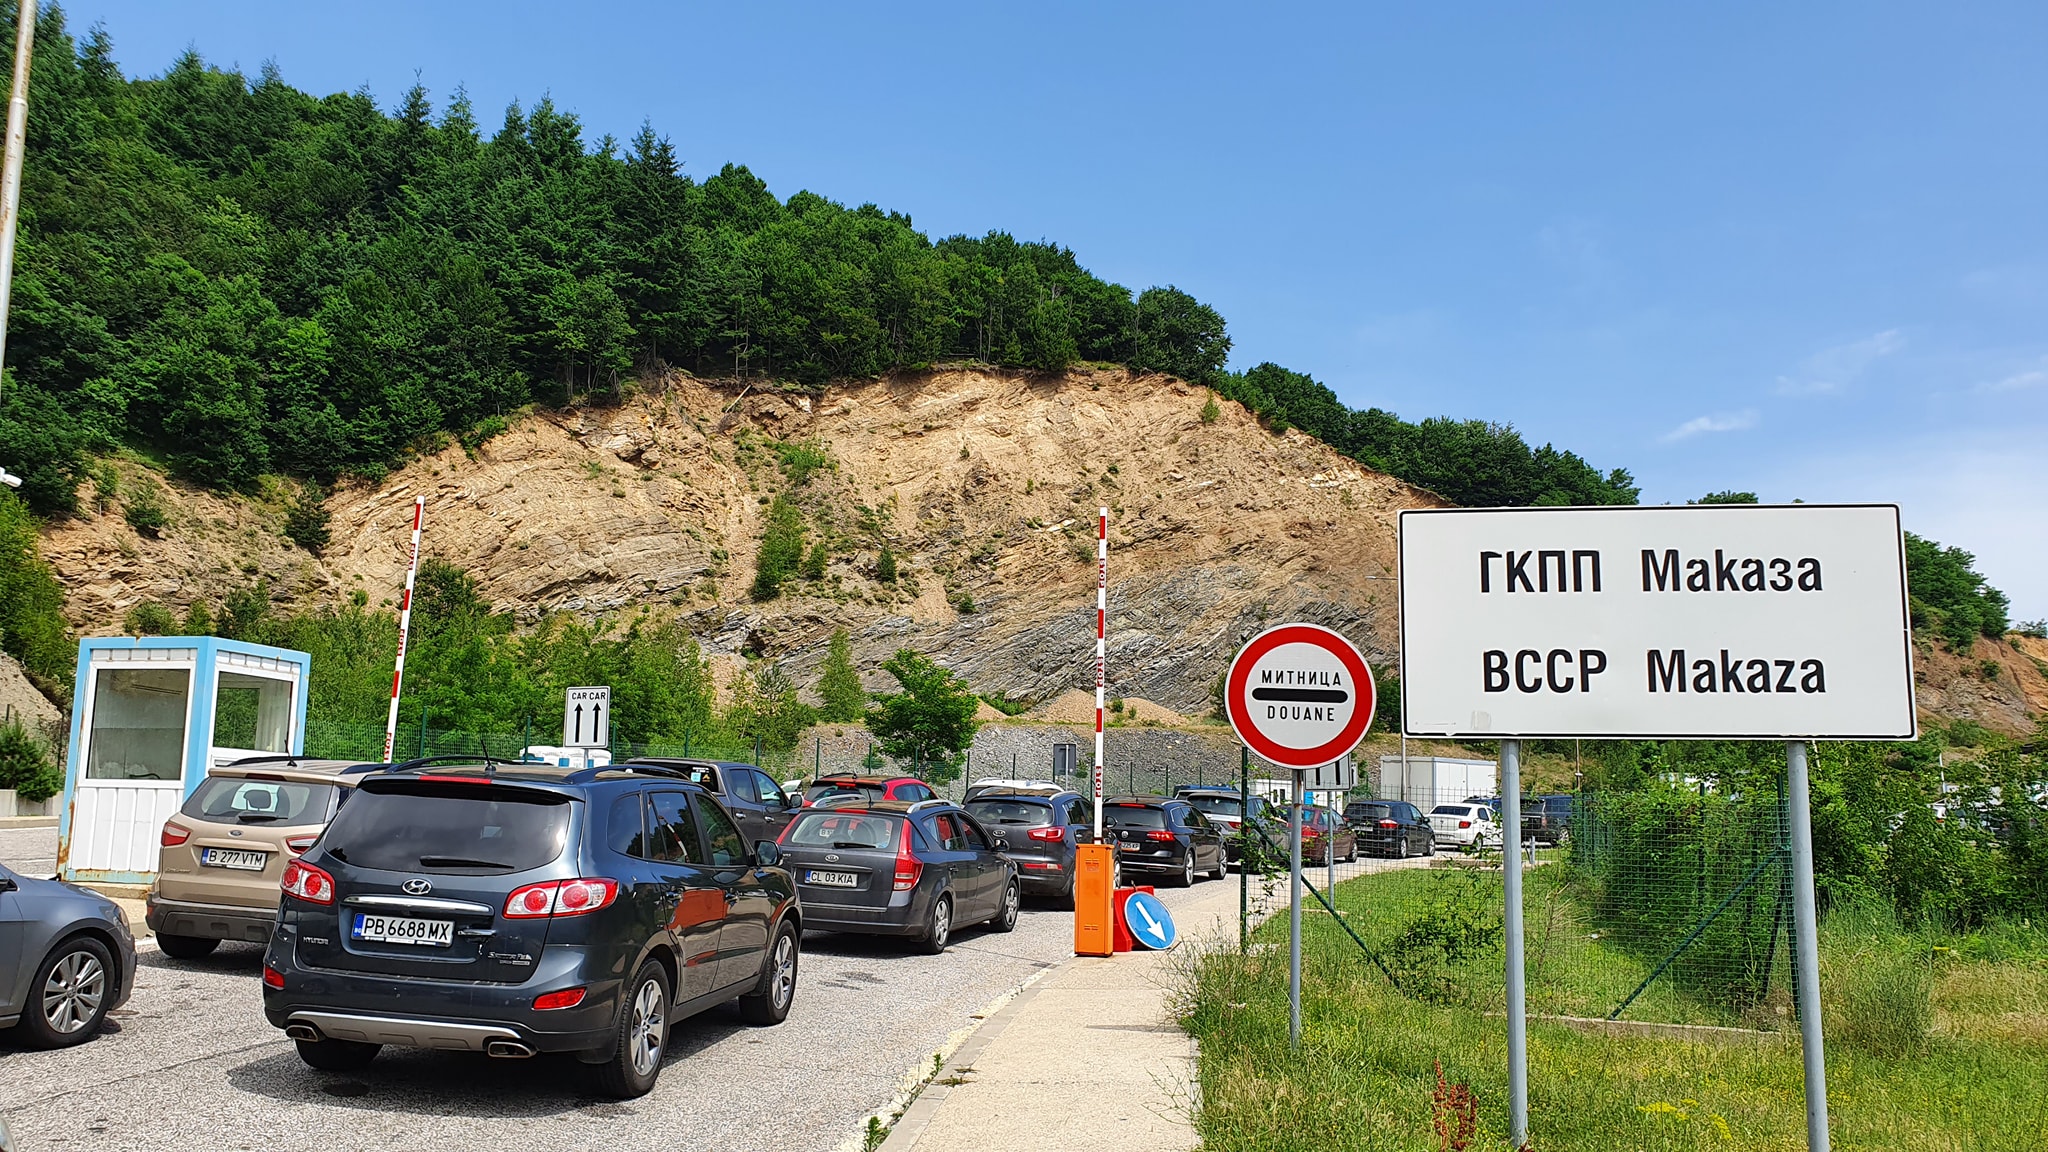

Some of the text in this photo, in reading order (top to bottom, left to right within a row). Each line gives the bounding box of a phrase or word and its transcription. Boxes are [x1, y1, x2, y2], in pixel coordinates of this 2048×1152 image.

[1479, 548, 1824, 593] ГКПП Маказа
[1261, 669, 1342, 687] МИТНИЦА
[1482, 648, 1827, 694] BCCP Makaza
[572, 691, 606, 700] CAR CAR
[1267, 705, 1335, 721] DOUANE
[209, 850, 264, 866] B 277 VTM
[812, 871, 853, 884] CL 03 KIA
[363, 915, 385, 935] PB
[388, 918, 426, 939] 6688
[428, 922, 451, 941] MX
